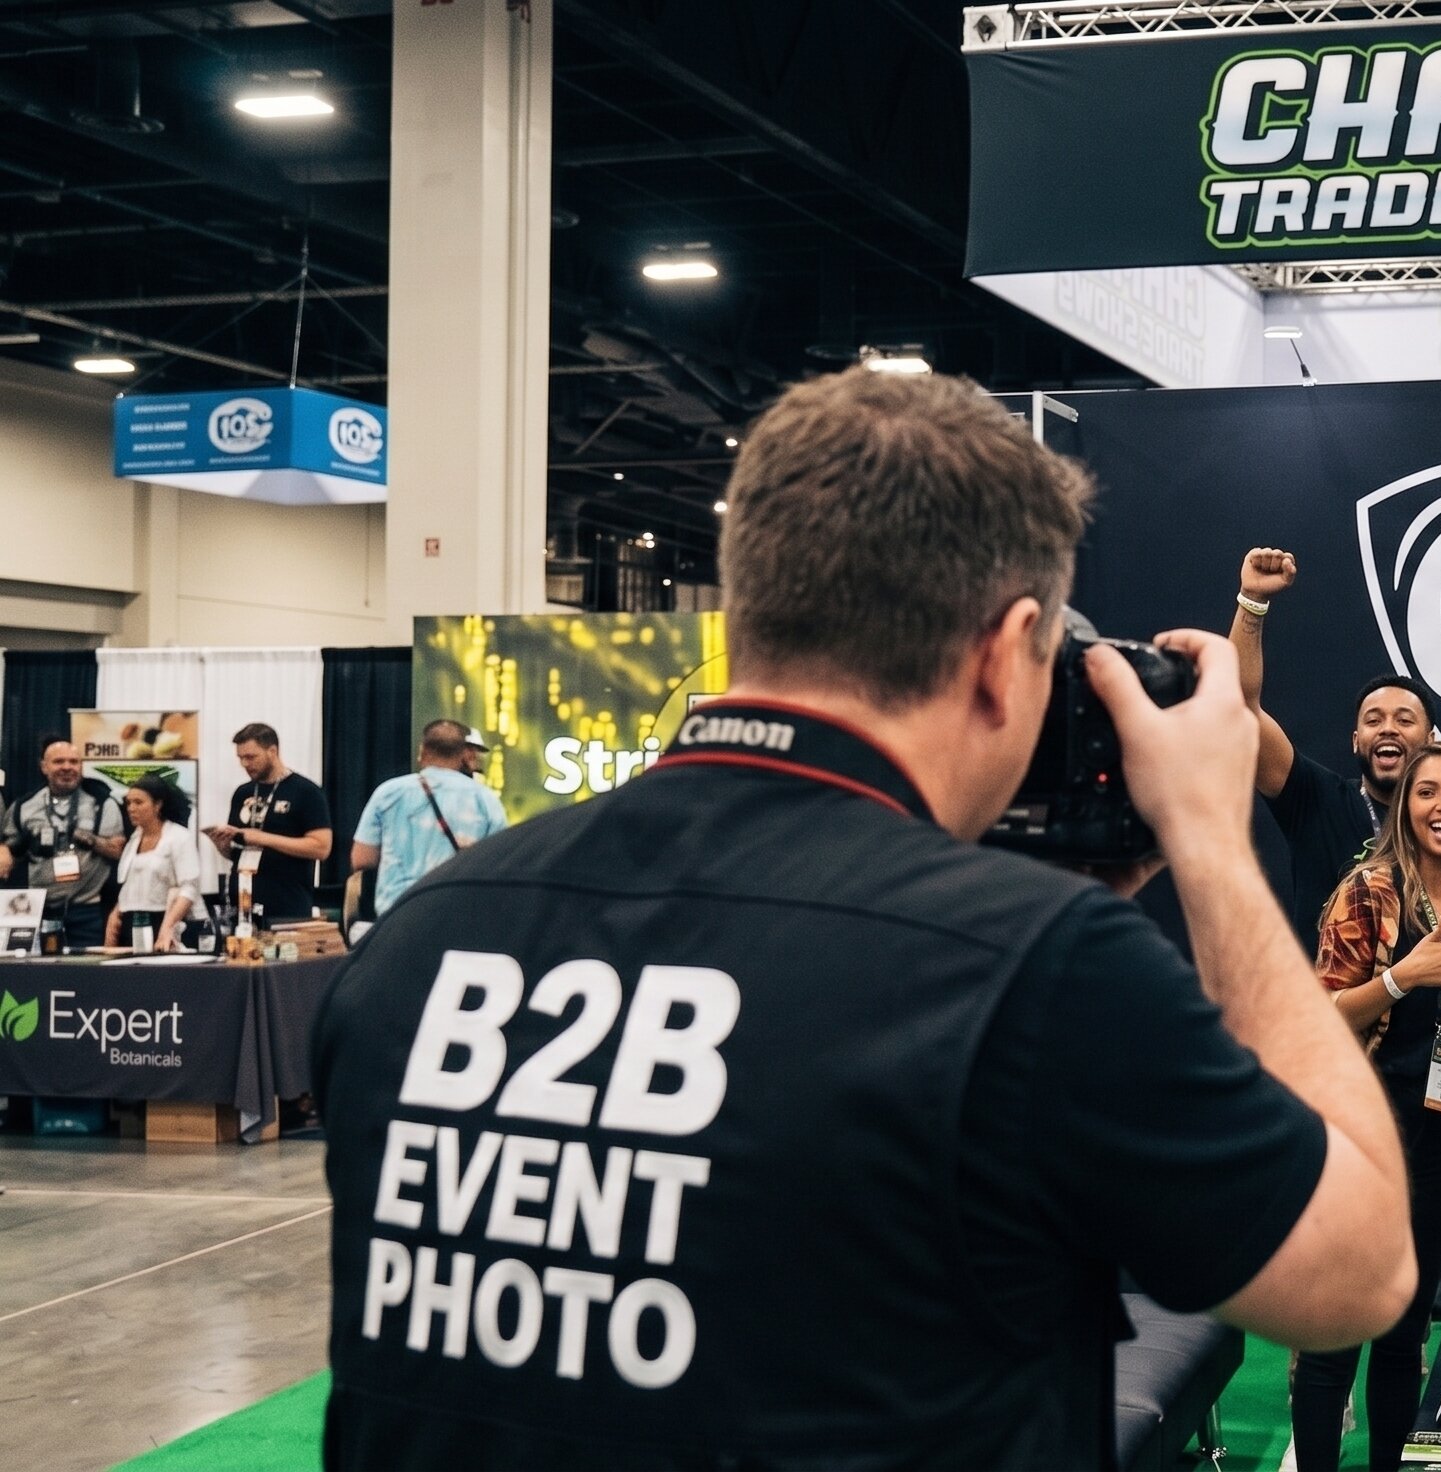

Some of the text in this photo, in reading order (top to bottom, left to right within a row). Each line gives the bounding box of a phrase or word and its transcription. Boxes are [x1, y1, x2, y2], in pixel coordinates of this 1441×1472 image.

[678, 714, 796, 752] Canon
[49, 990, 184, 1053] Expert
[109, 1047, 183, 1067] Botanicals
[398, 949, 742, 1136] B2B
[373, 1119, 712, 1266] EVENT
[361, 1237, 697, 1390] PHOTO
